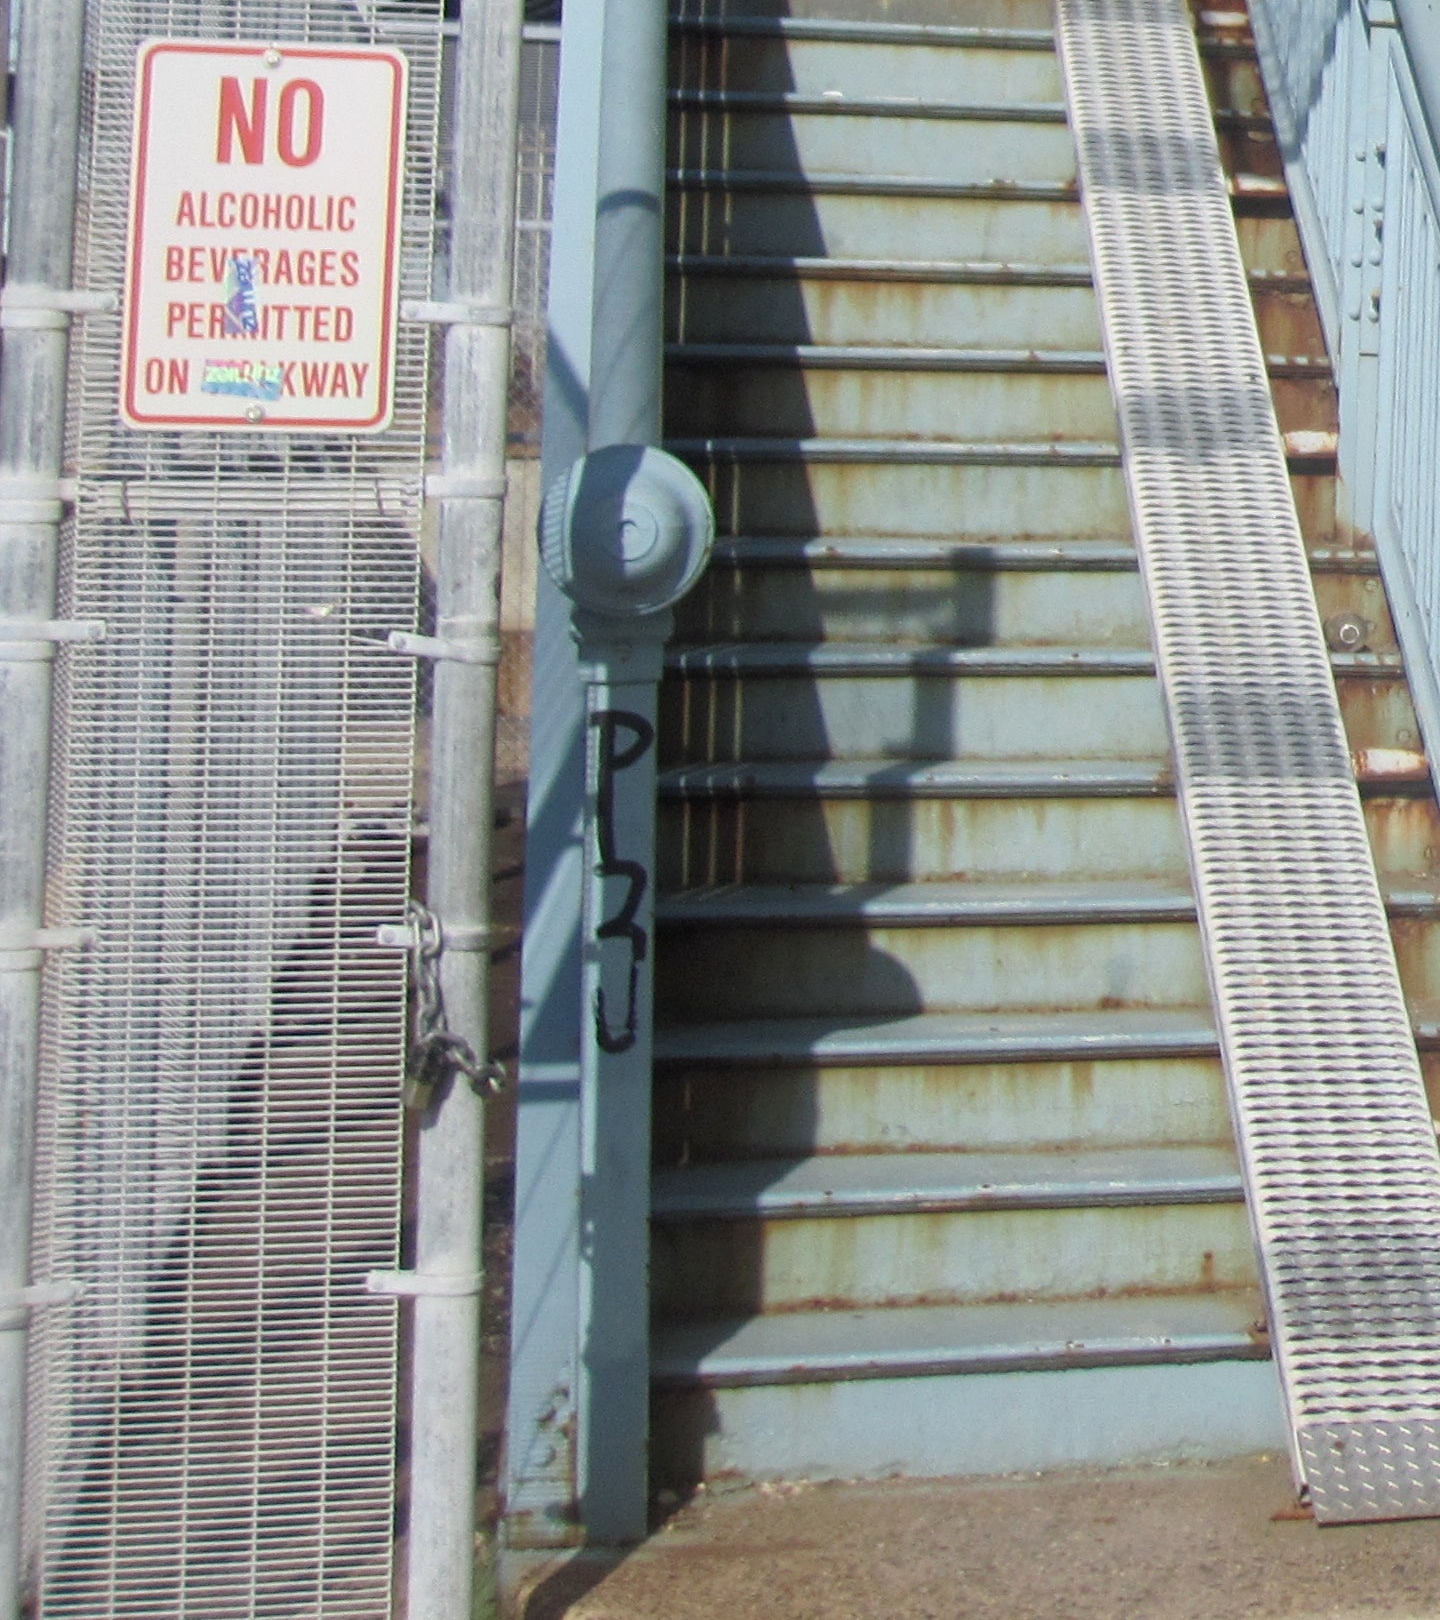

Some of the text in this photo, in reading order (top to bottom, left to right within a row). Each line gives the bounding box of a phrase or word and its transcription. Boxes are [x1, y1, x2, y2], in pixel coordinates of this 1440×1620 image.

[217, 77, 324, 168] NO
[176, 191, 356, 232] ALCOHOLIC
[167, 301, 354, 342] PERITTED
[145, 358, 189, 394] ON
